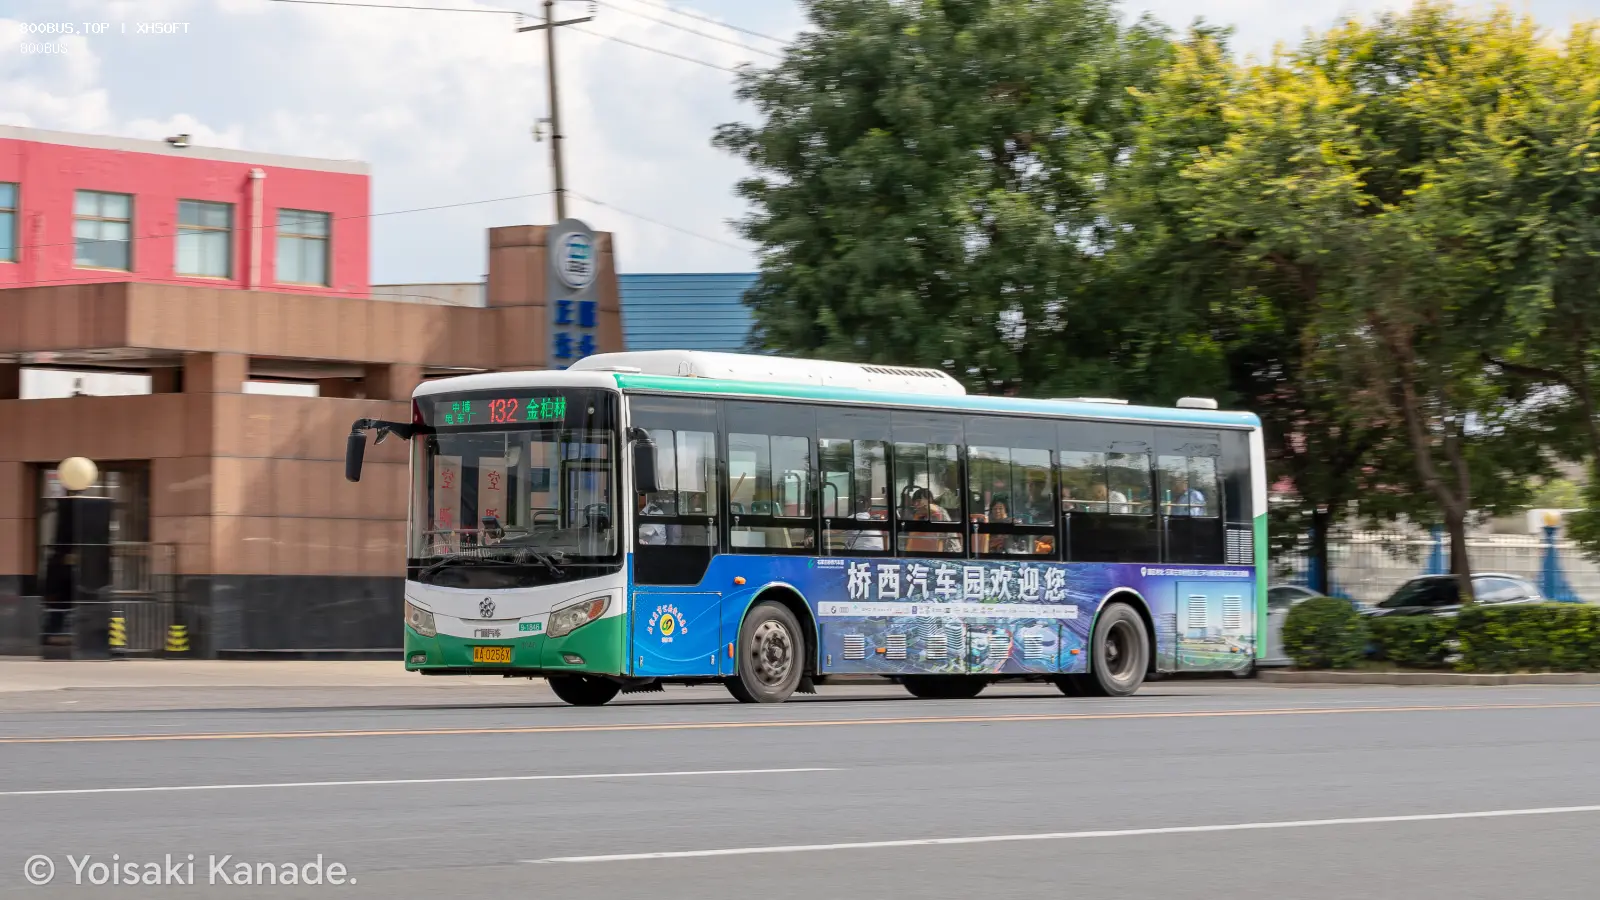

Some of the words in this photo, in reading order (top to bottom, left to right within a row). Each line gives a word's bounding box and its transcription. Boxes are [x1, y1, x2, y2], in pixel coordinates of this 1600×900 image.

[445, 412, 477, 425] 电车厂
[488, 398, 518, 423] 132
[526, 397, 566, 420] 金柏林
[847, 561, 1066, 600] 桥西汽车园欢迎您
